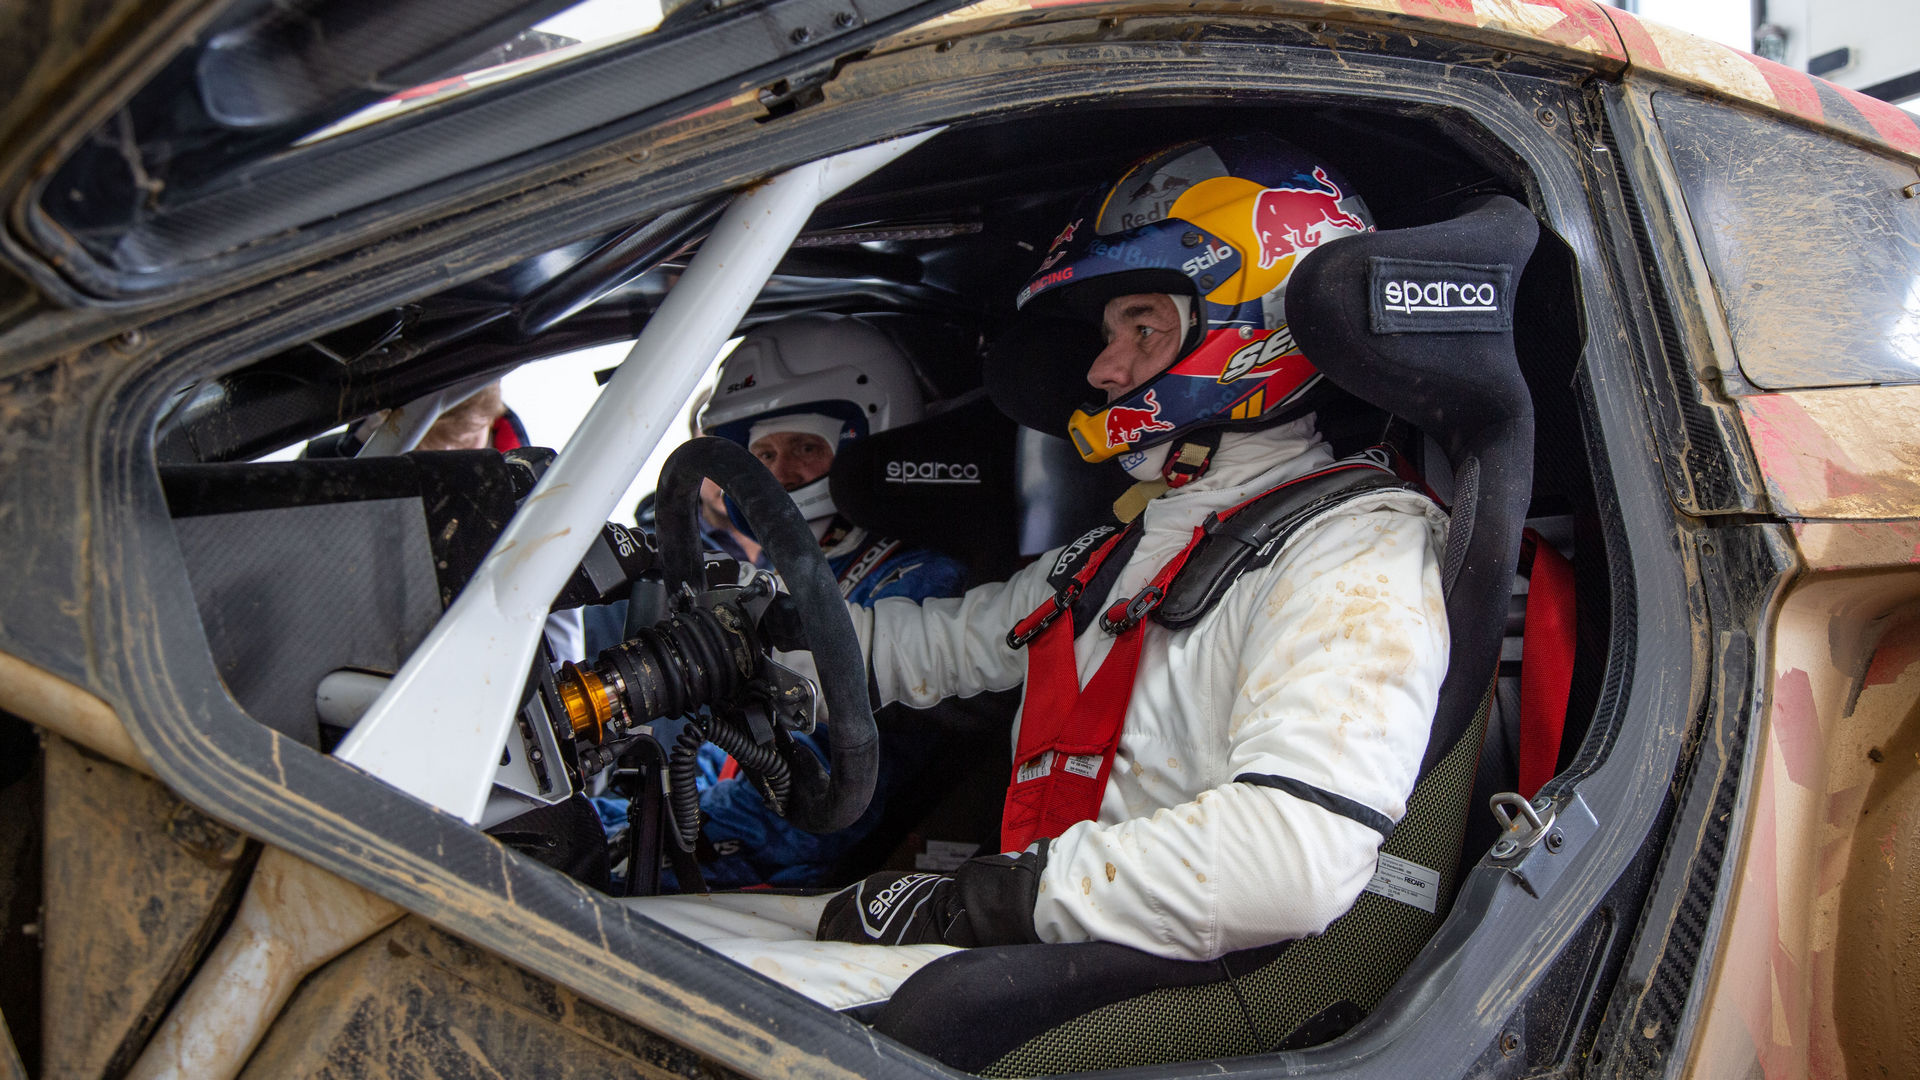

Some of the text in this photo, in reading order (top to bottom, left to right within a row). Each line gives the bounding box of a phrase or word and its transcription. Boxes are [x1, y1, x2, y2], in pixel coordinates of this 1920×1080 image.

[1182, 243, 1233, 277] Stilo
[1385, 281, 1497, 314] sparco
[1220, 326, 1298, 383] SE
[885, 461, 981, 483] sparco
[840, 537, 900, 600] spar
[1052, 525, 1117, 577] sparco
